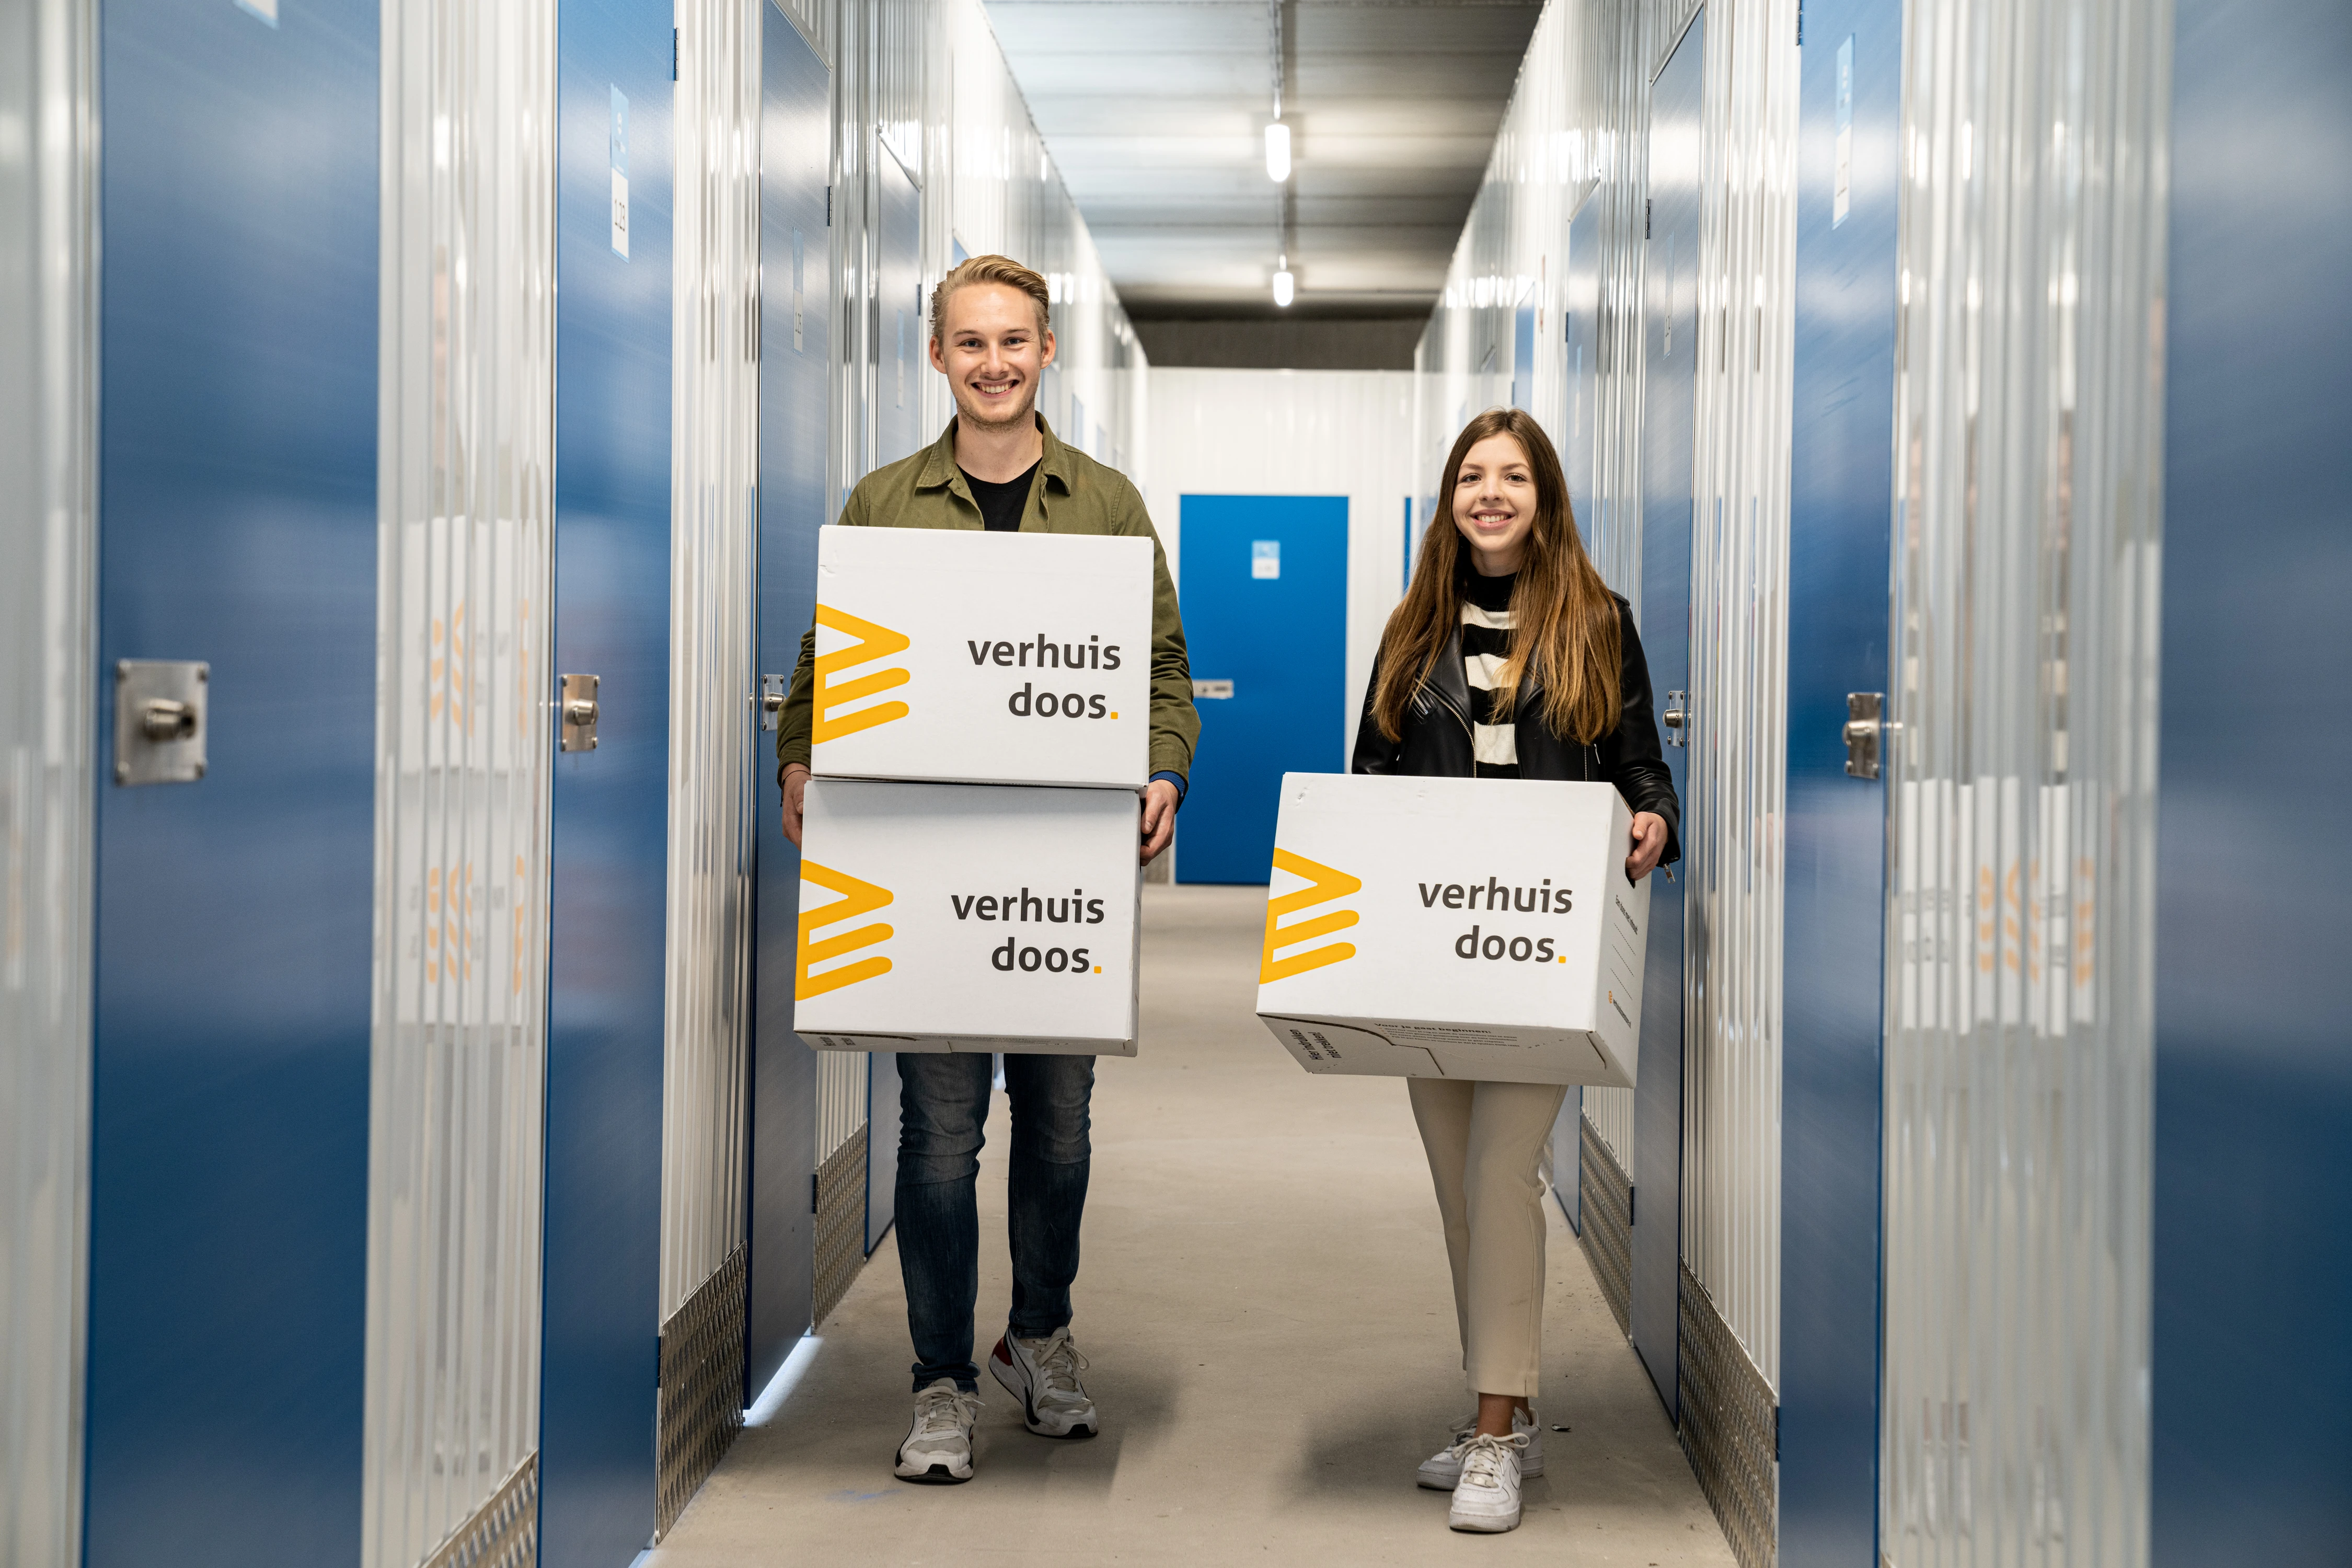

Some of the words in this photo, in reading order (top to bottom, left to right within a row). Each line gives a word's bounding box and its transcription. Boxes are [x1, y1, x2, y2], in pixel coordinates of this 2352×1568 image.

[967, 633, 1121, 671] verhuis
[1008, 682, 1119, 720] doos.
[951, 887, 1105, 924] verhuis
[1418, 877, 1573, 914] verhuis
[991, 937, 1102, 974] doos.
[1455, 925, 1567, 964] doos.
[1308, 1050, 1324, 1060] Hier
[1324, 1050, 1342, 1058] niet
